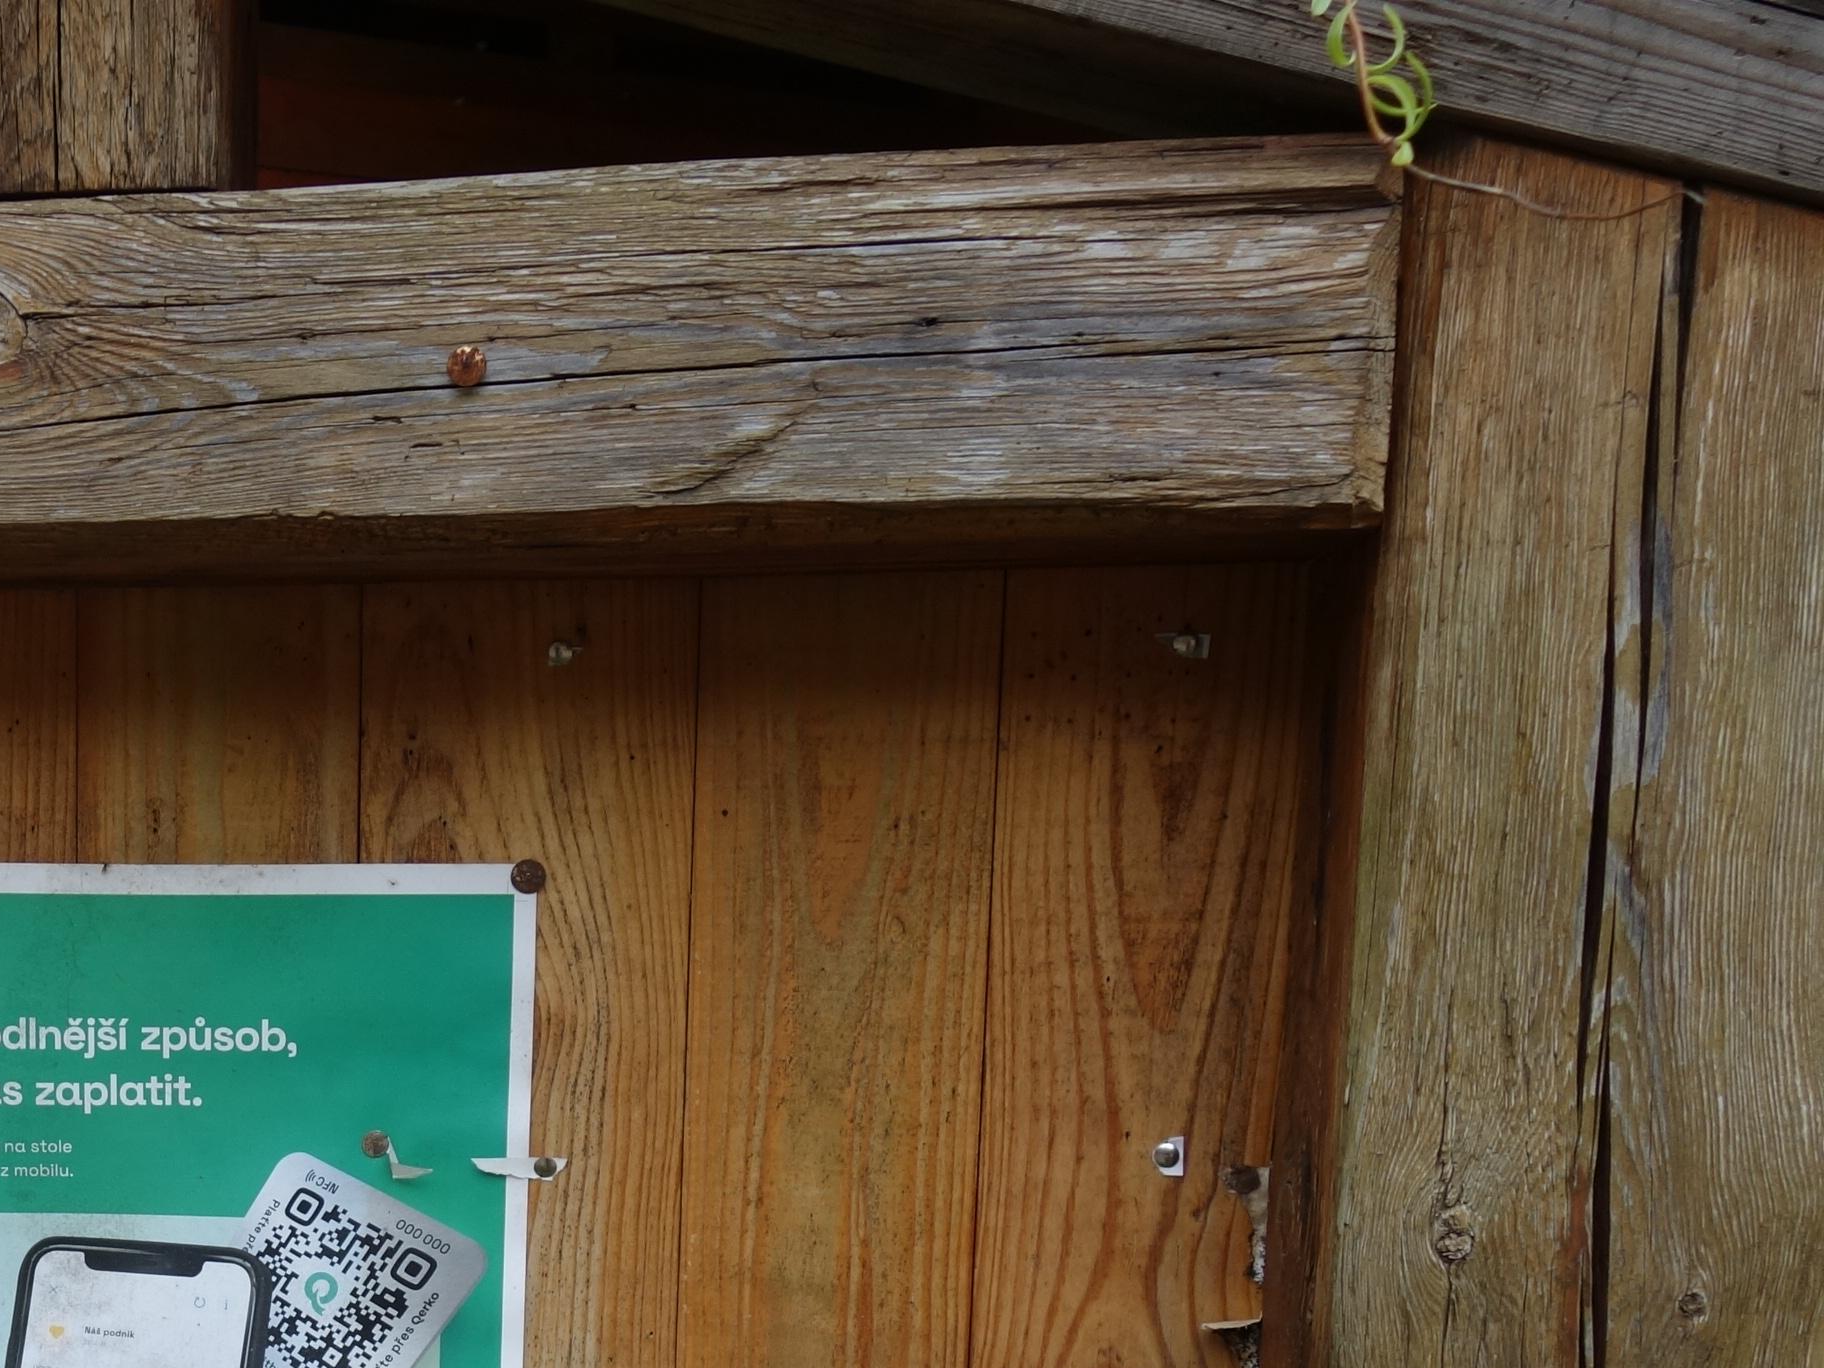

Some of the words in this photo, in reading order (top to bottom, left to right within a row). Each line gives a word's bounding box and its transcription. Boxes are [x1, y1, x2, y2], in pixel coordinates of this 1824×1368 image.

[141, 1017, 298, 1058] způsob,
[35, 1074, 203, 1113] zaplatit.
[5, 1142, 26, 1153] na
[31, 1140, 72, 1154] stole
[1, 1166, 8, 1177] z
[14, 1163, 74, 1177] mobilu.
[392, 1324, 415, 1355] přes
[411, 1292, 440, 1326] Qerko
